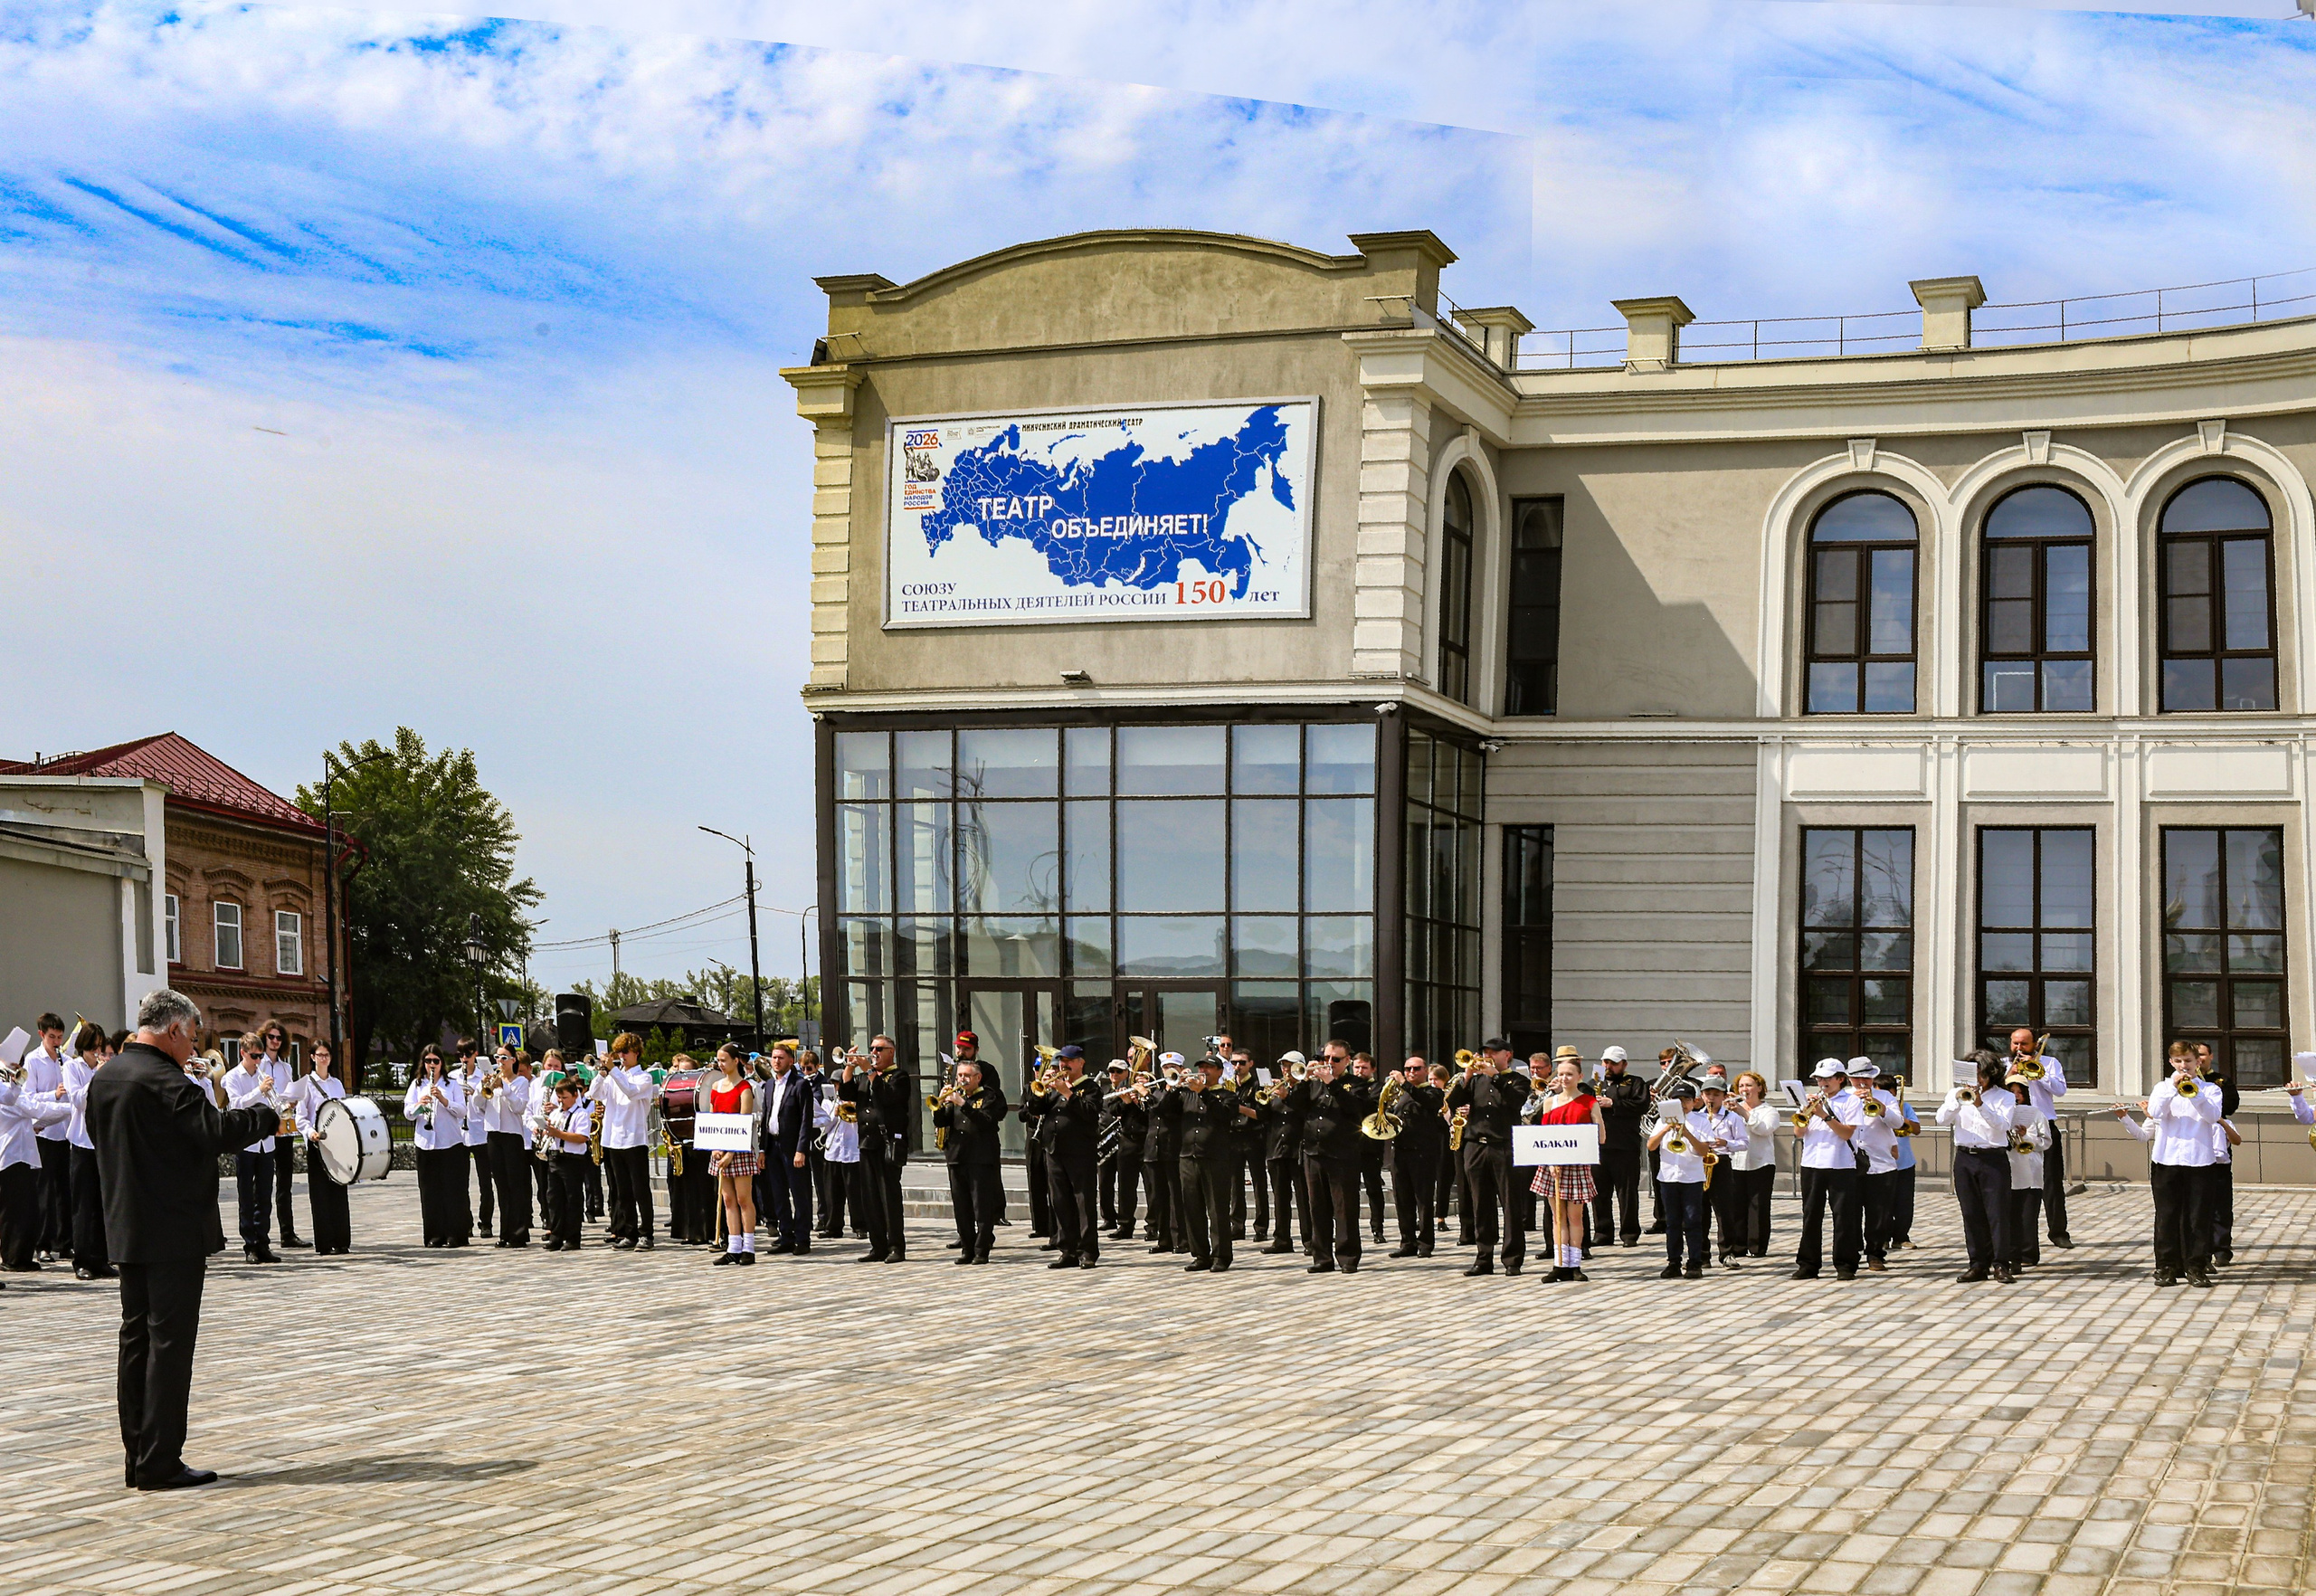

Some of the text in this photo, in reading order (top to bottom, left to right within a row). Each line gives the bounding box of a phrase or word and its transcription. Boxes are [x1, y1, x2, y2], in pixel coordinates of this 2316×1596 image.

[906, 432, 938, 446] 2026
[977, 495, 1054, 520] ТЕАТР
[1051, 514, 1209, 540] ОБЪЕДИНЯЕТ!
[901, 583, 957, 596] СОЮЗУ
[901, 580, 1280, 613] ТЕАТРАЛЬНЫХ ДЕЯТЕЛЕЙ РОССИИ 150 лет
[698, 1126, 748, 1135] МИНУСИНСК
[1533, 1139, 1578, 1149] АБАКАН
